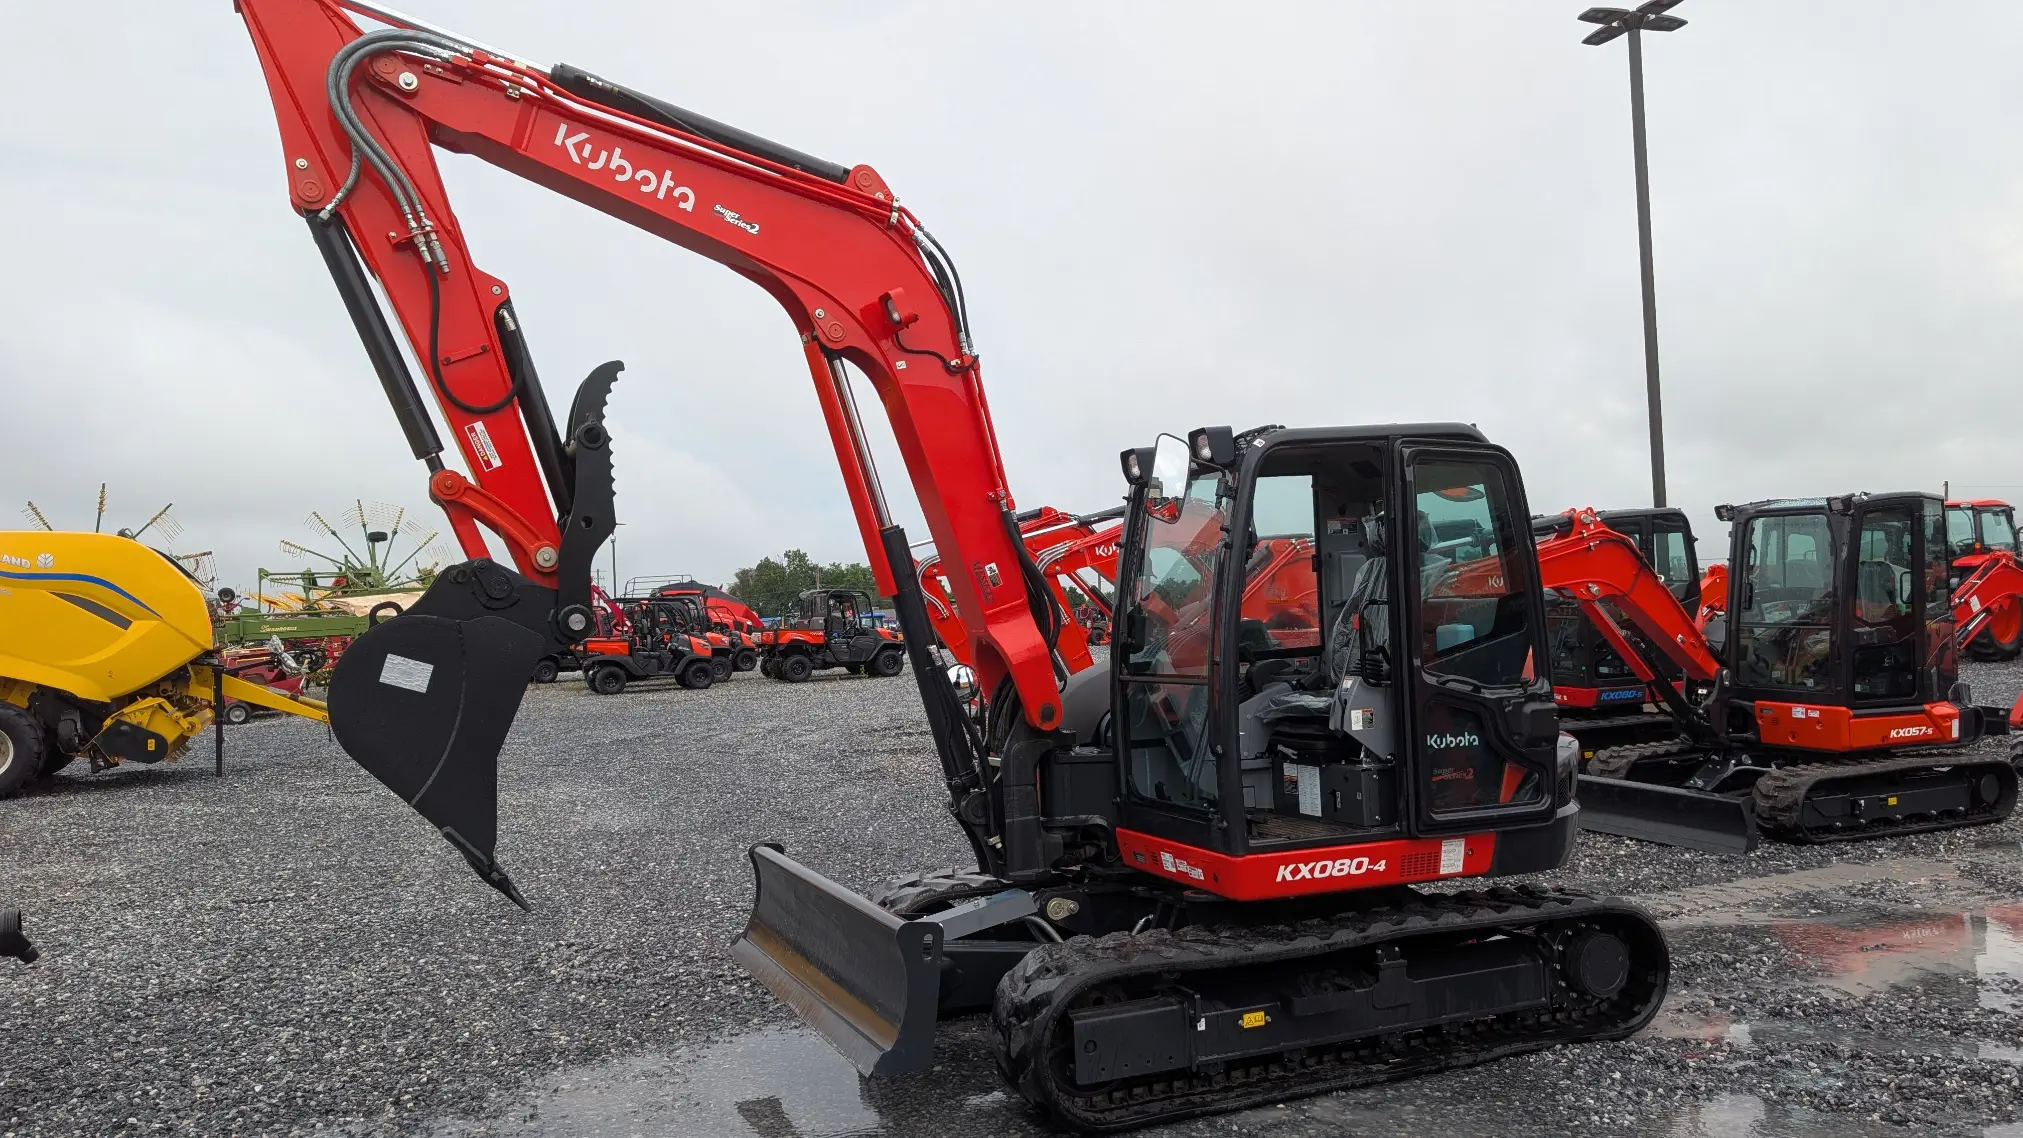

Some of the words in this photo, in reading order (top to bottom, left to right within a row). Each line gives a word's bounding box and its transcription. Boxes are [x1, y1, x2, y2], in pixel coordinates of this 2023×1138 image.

[554, 122, 695, 212] Kubota
[713, 204, 740, 219] Super
[470, 432, 486, 457] DANGER
[1600, 690, 1643, 701] KX080-5
[1427, 731, 1479, 749] Kubota
[1889, 726, 1934, 739] KX057-5
[1432, 767, 1456, 777] Super
[1276, 857, 1387, 882] KX080-4
